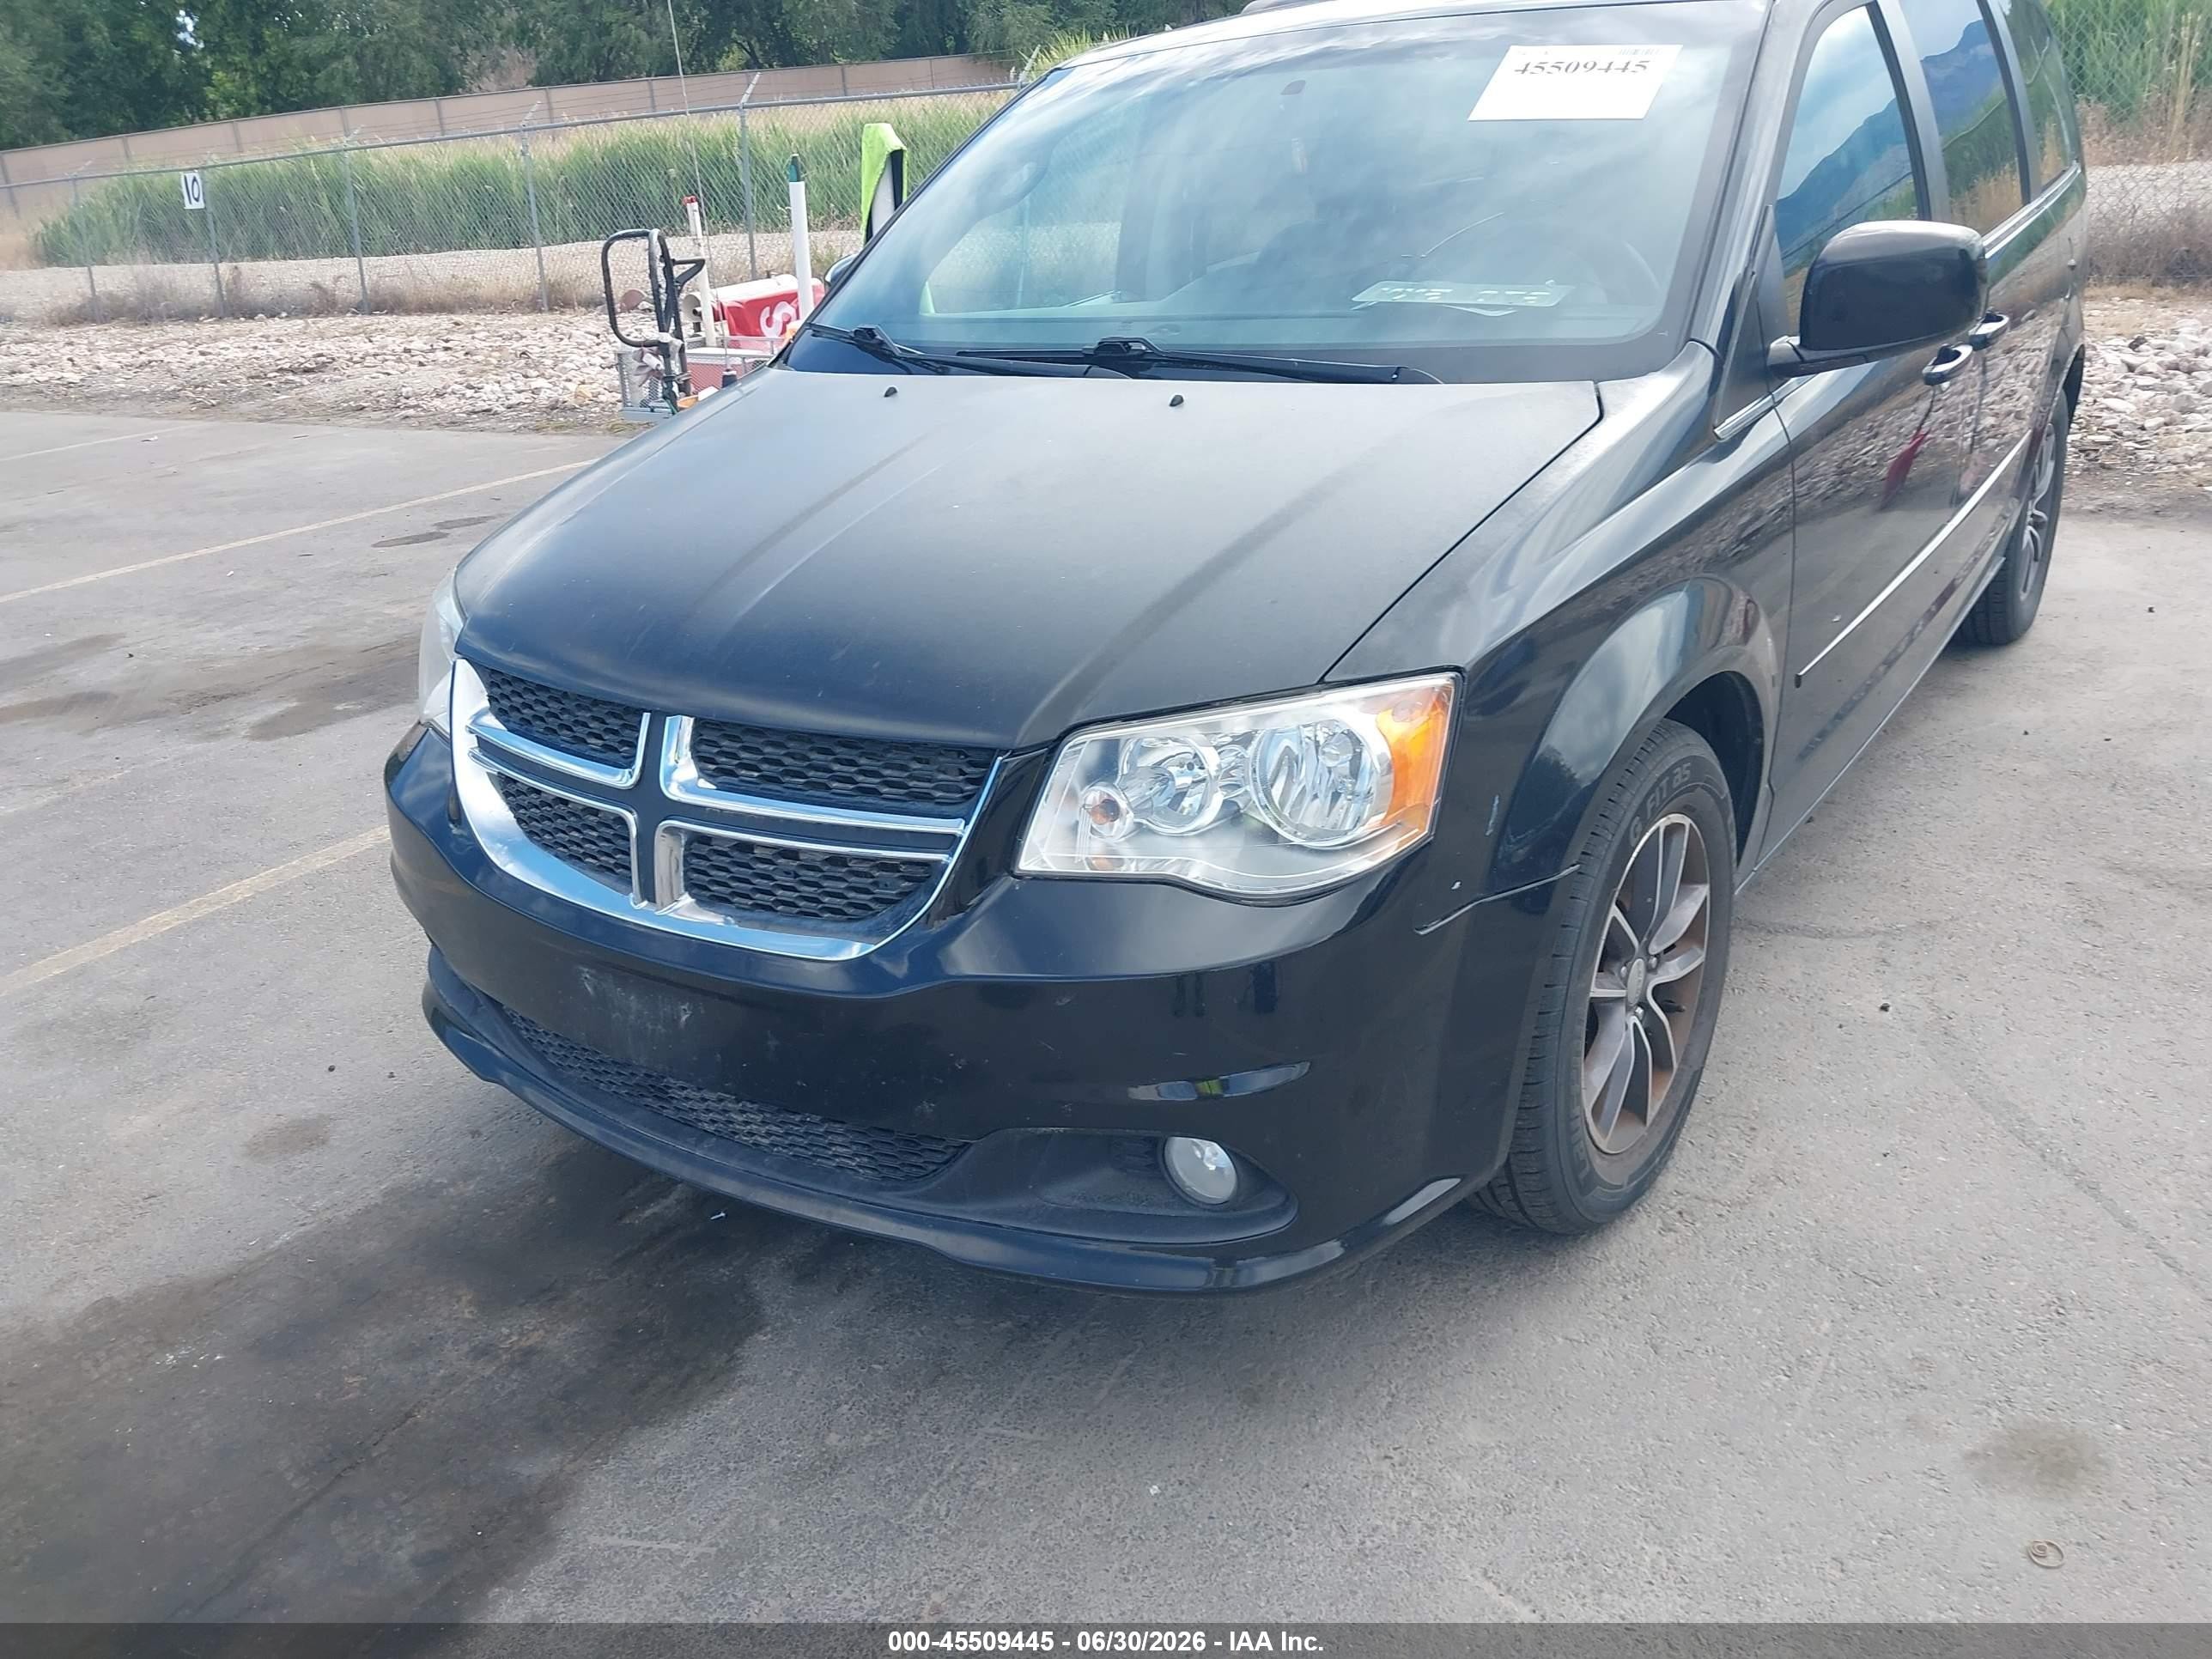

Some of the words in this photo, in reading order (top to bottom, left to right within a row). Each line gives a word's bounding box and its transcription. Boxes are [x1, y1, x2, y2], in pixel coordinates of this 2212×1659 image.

[1515, 60, 1650, 75] 45509445
[184, 175, 200, 205] 10
[1647, 776, 1669, 820] FIT
